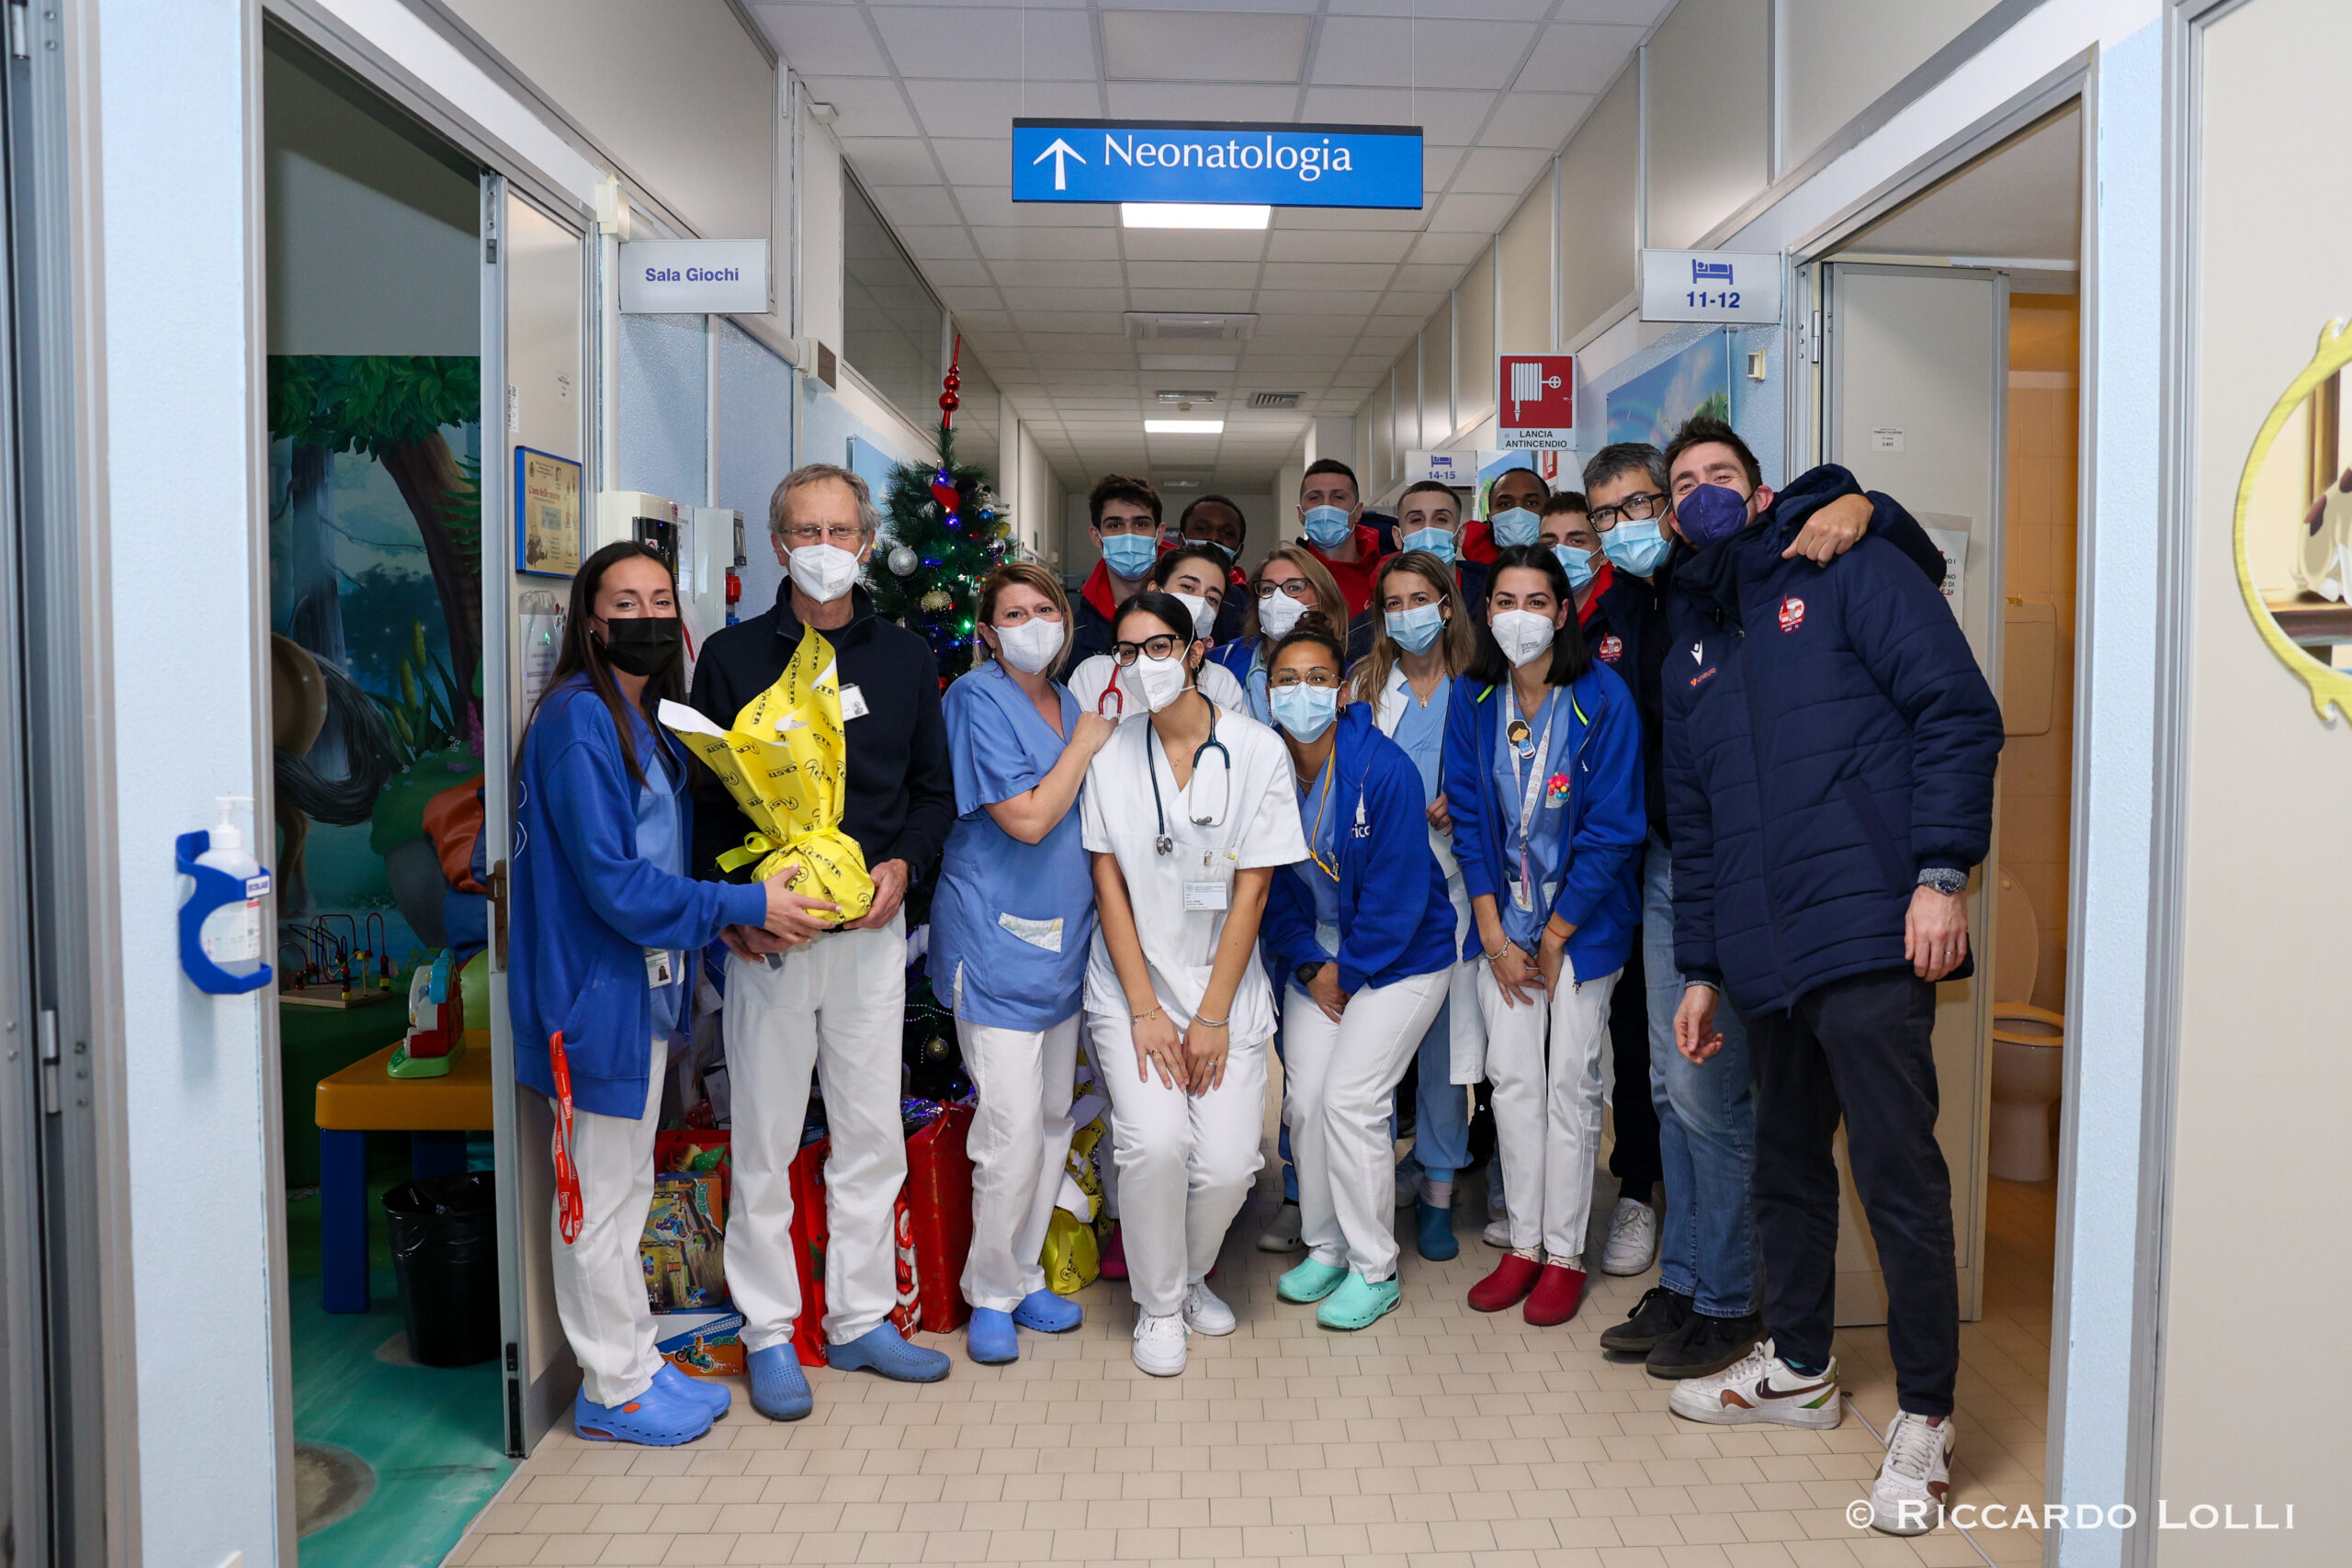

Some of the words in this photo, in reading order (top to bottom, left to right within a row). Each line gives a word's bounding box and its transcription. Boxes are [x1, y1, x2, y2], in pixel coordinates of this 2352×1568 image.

[1104, 133, 1352, 182] Neonatologia
[645, 267, 681, 282] Sala
[685, 267, 739, 282] Giochi
[1686, 291, 1741, 309] 11-12
[1519, 430, 1553, 438] LANCIA
[1505, 440, 1567, 448] ANTINCENDIO
[1428, 470, 1456, 479] 14-15
